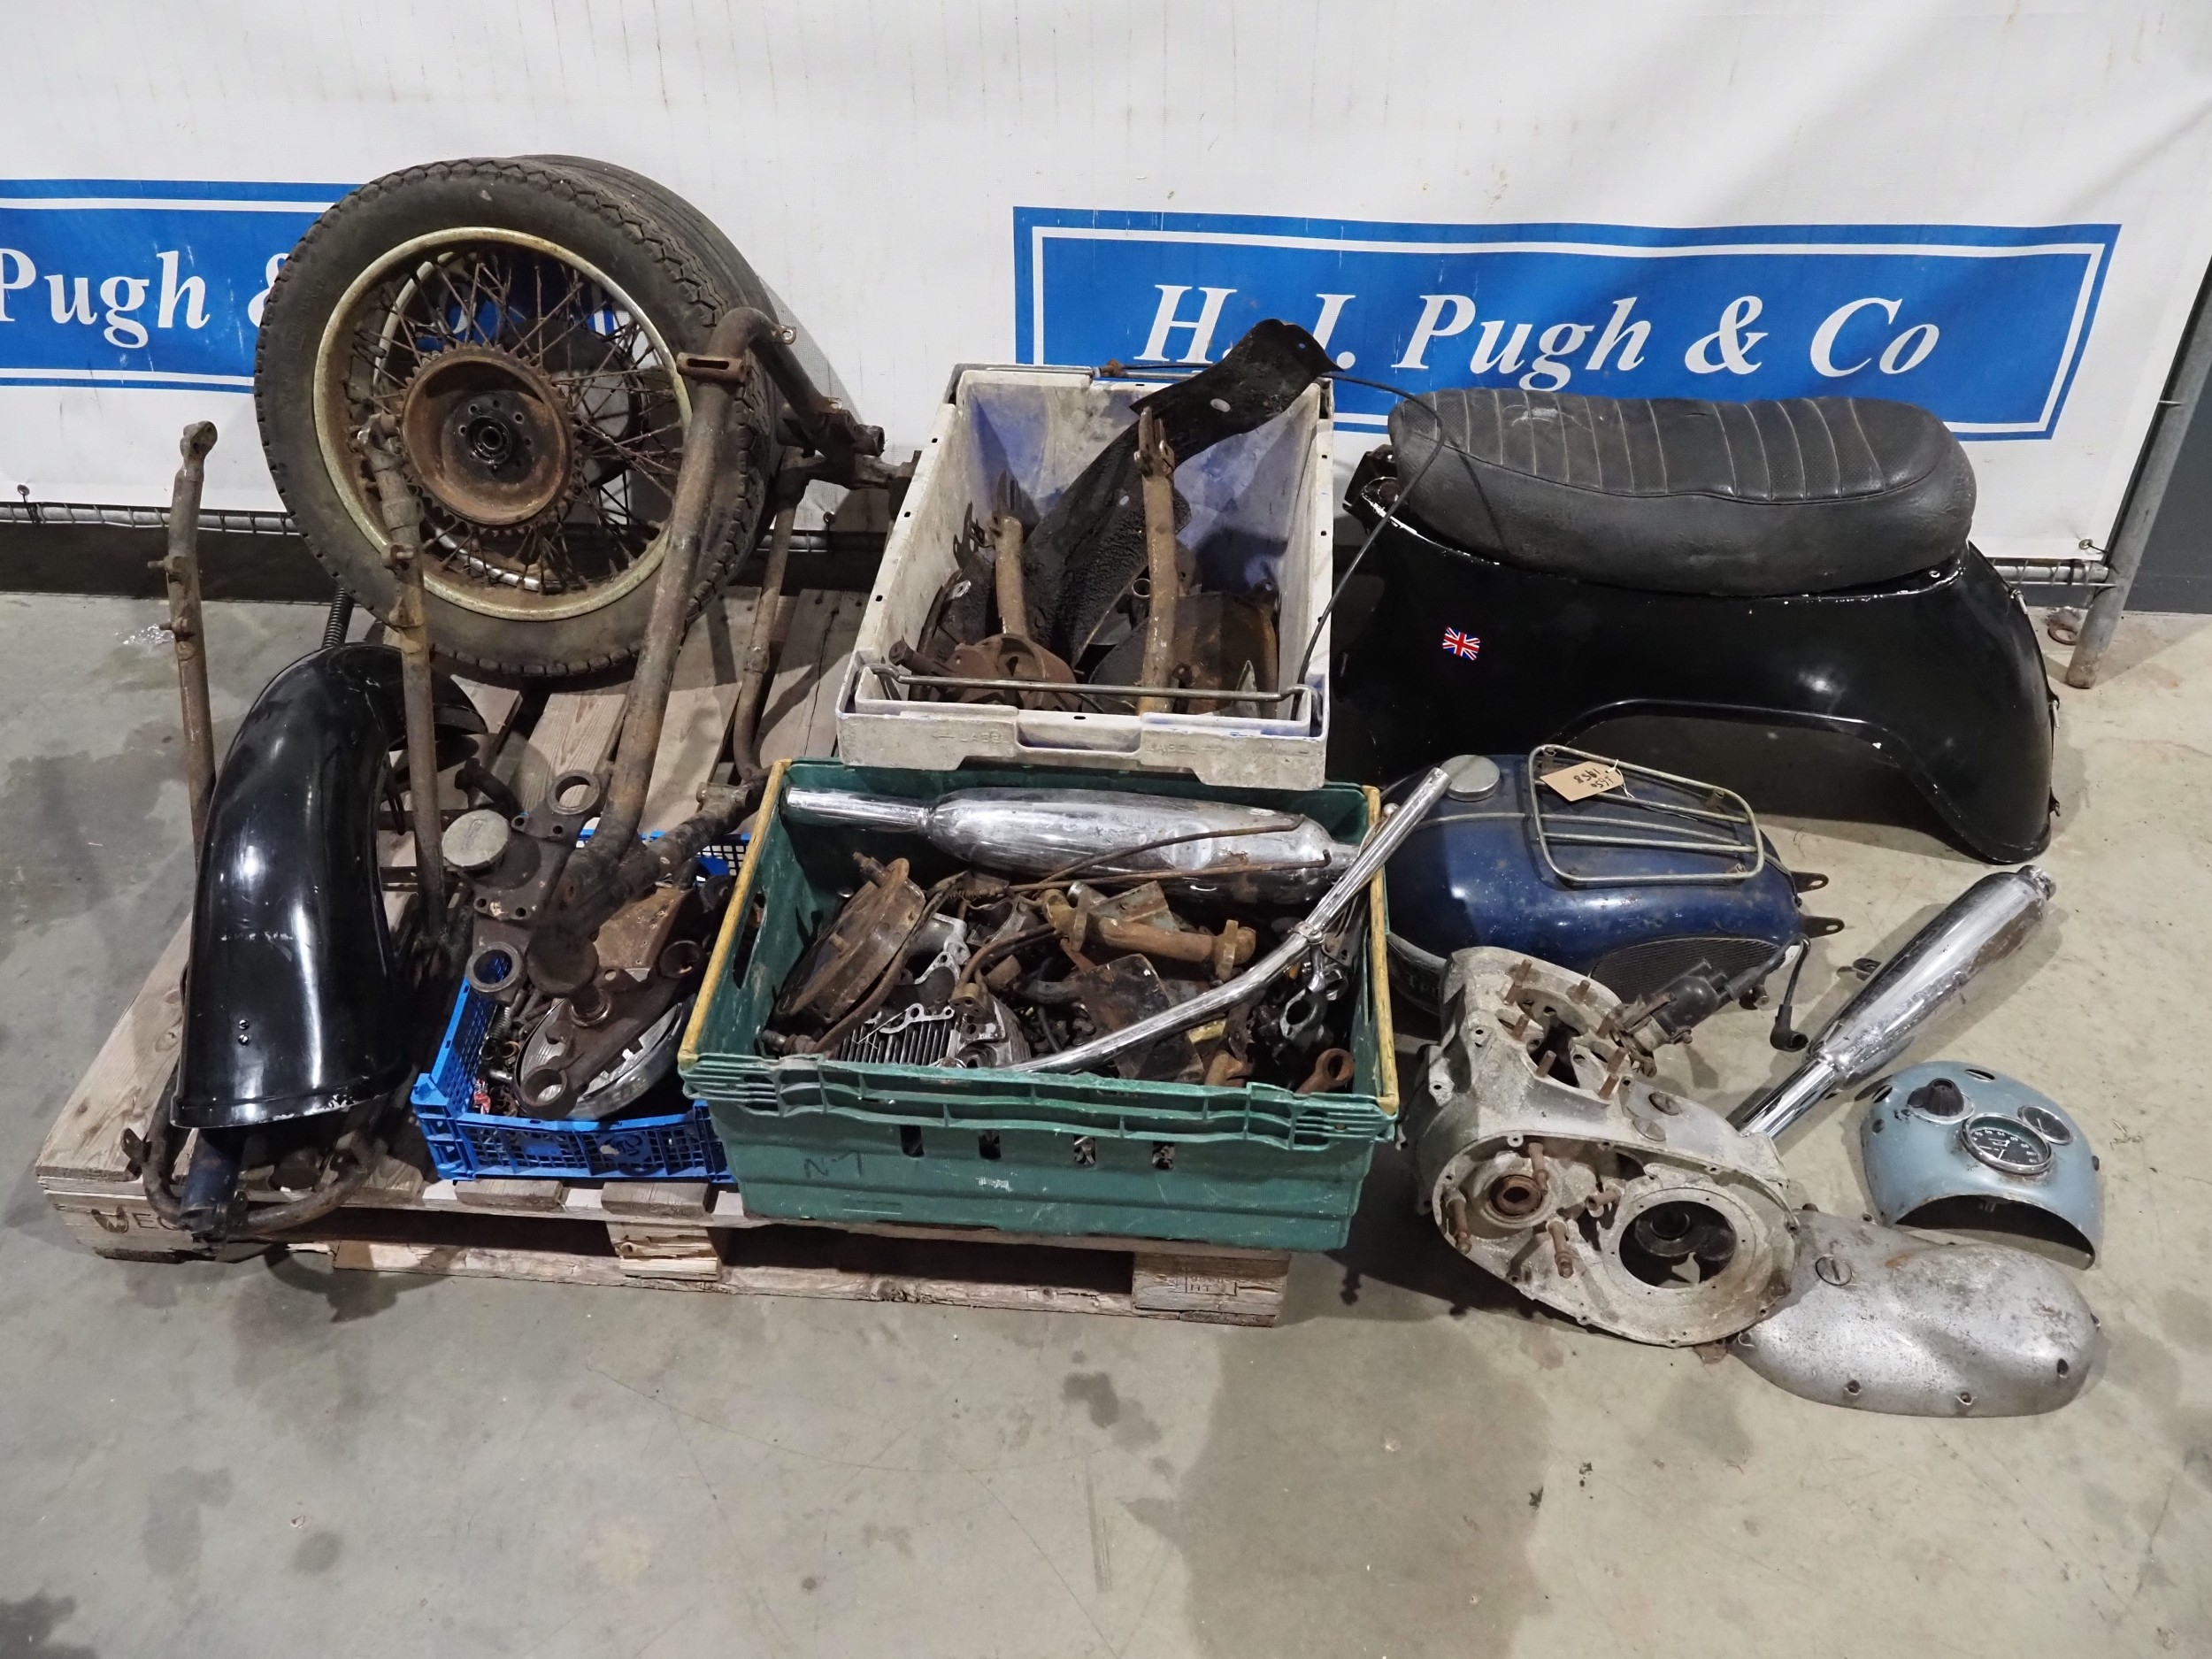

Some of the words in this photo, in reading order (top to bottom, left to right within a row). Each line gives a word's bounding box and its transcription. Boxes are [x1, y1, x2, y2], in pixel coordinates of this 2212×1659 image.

[0, 248, 211, 349] Pugh
[1133, 284, 1236, 366] H
[1391, 294, 1652, 392] Pugh
[1684, 295, 1769, 375] &
[1809, 296, 1940, 378] Co
